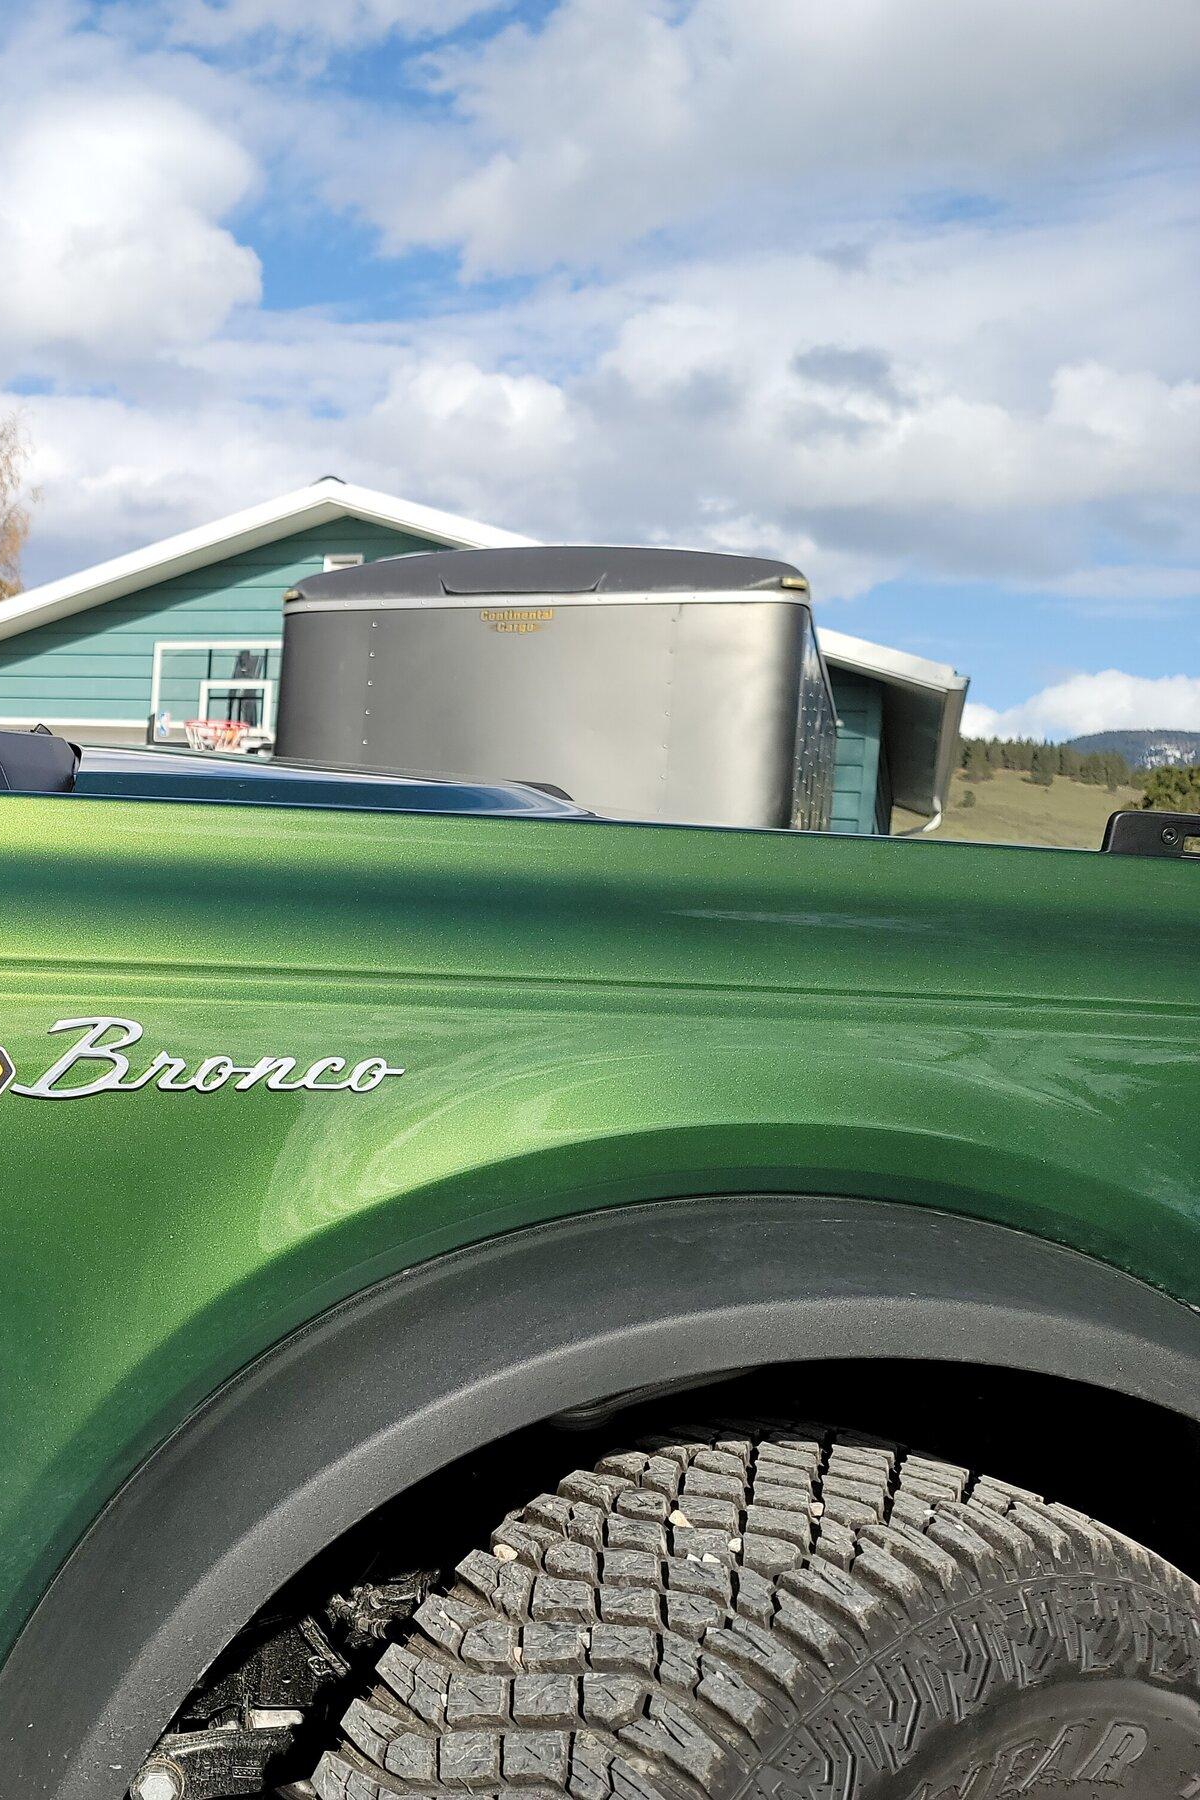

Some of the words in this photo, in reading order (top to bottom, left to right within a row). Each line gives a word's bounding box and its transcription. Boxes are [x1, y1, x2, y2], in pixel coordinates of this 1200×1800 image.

[480, 608, 553, 621] Continental
[496, 622, 535, 635] Cargo
[10, 1016, 405, 1098] Bronco
